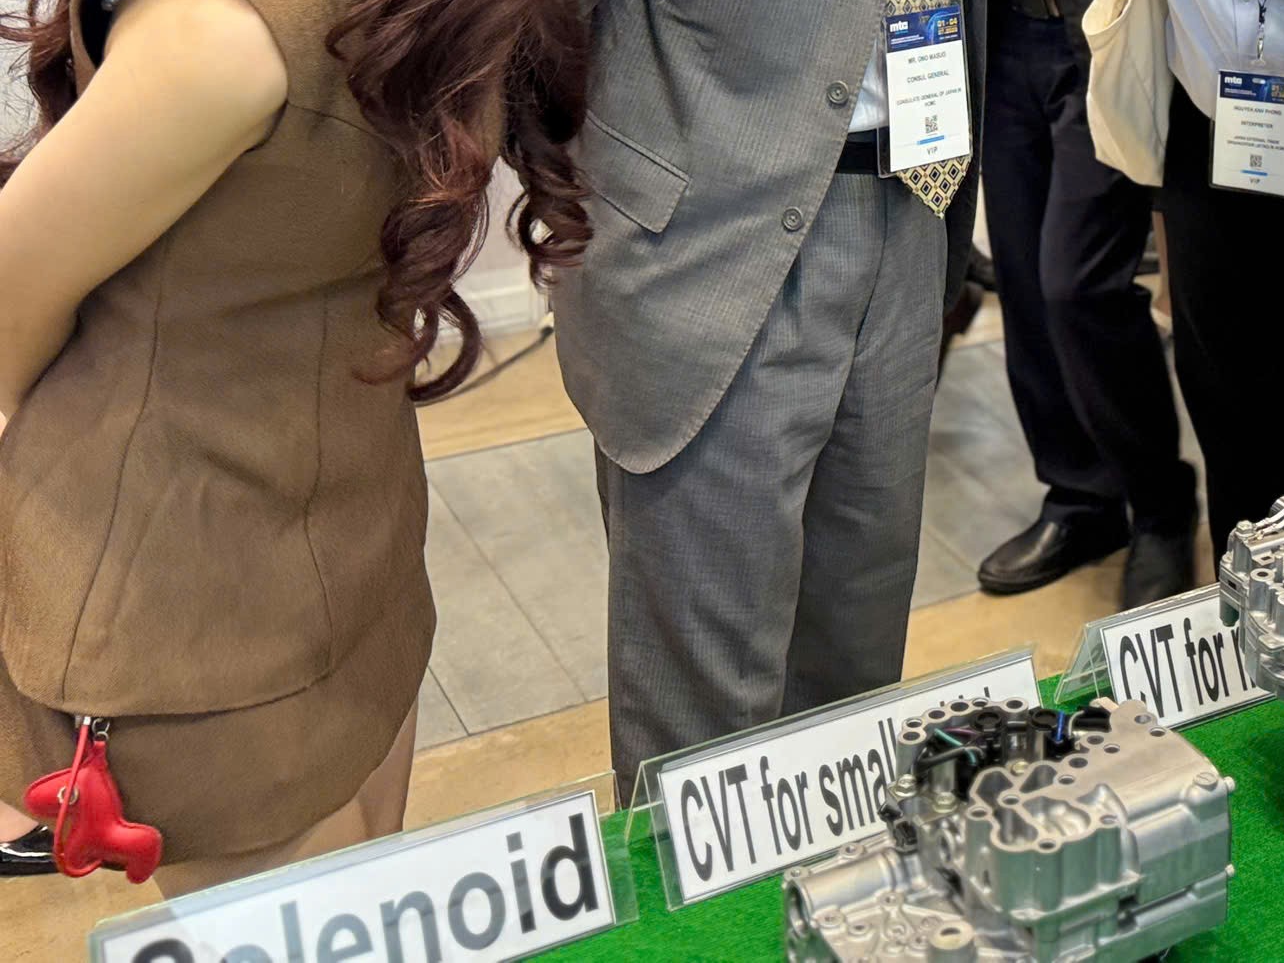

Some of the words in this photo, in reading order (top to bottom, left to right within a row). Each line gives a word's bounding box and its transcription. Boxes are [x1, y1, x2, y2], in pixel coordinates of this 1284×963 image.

[926, 146, 938, 156] VIP
[1119, 623, 1183, 719] CVT
[1183, 617, 1231, 706] for
[681, 763, 758, 882] CVT
[760, 755, 814, 856] for
[131, 813, 600, 963] lenoid
